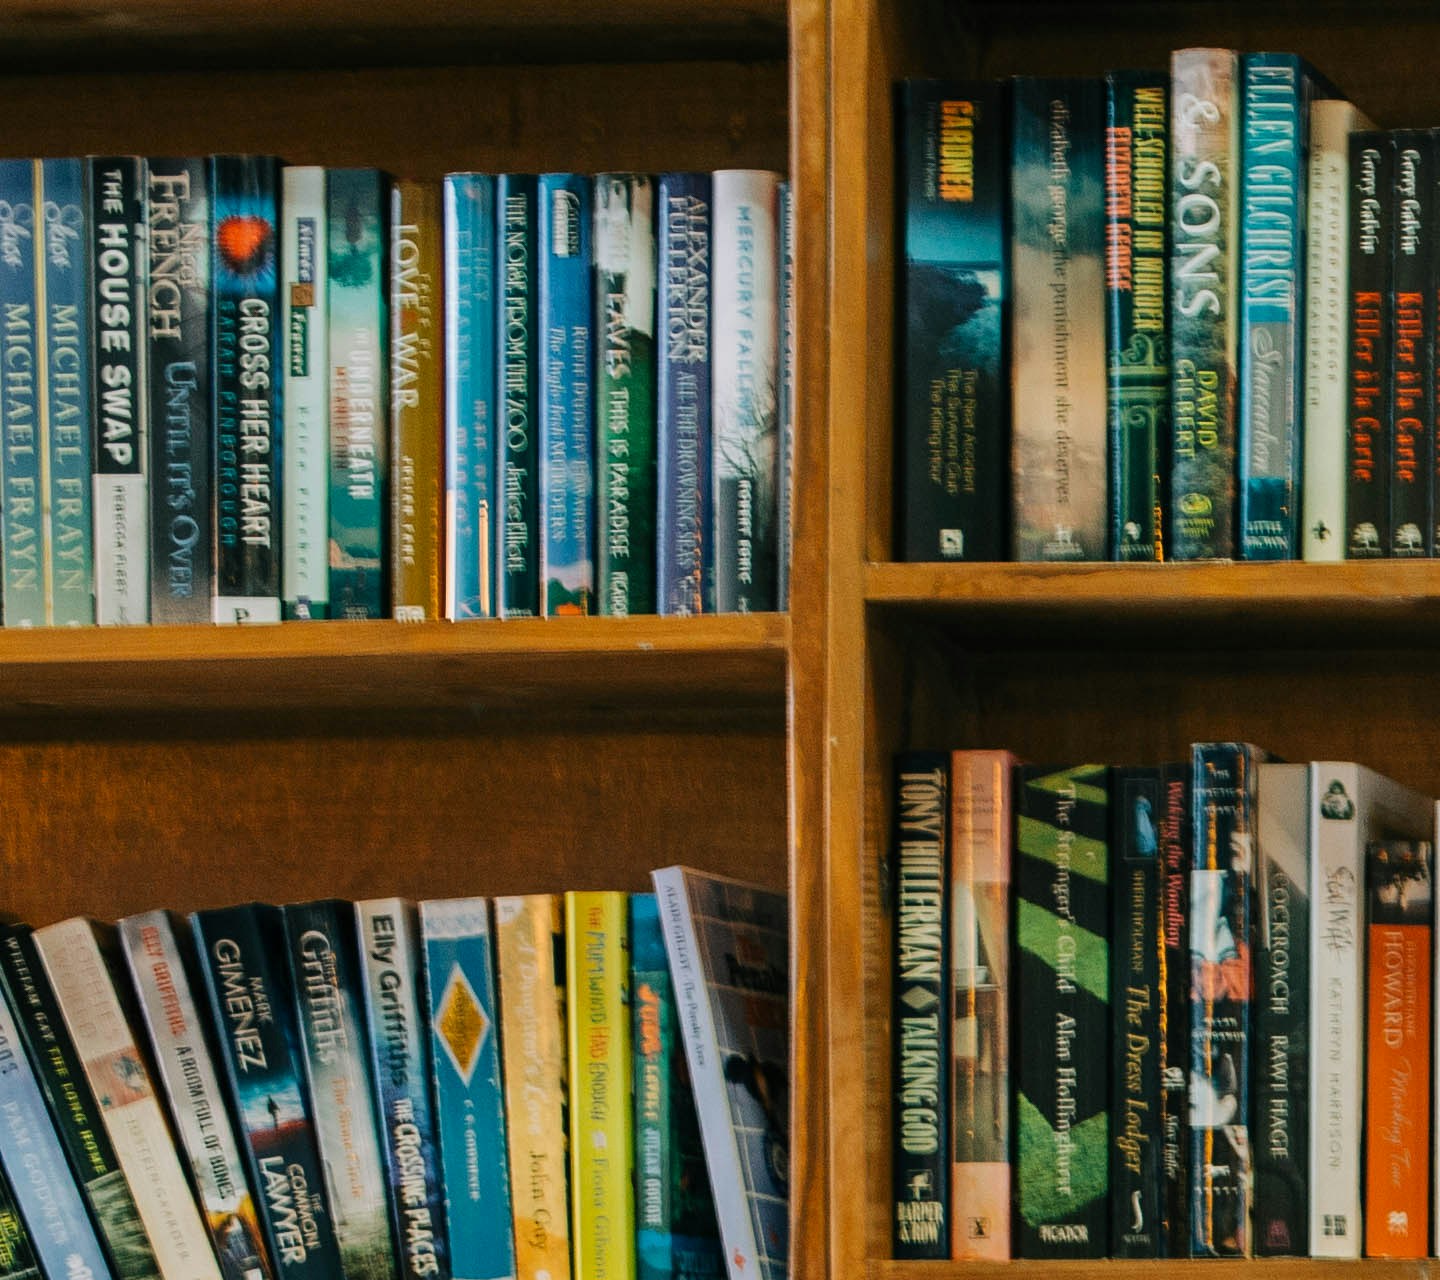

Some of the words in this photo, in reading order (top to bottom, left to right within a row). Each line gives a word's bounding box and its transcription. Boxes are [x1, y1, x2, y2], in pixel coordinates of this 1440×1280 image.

[103, 170, 125, 214] THE
[938, 101, 976, 201] GARDNER
[1178, 158, 1221, 318] SONS
[100, 223, 130, 349] HOUSE
[240, 298, 269, 390] CROSS
[101, 364, 132, 466] SWAP
[240, 399, 269, 450] HER
[240, 463, 271, 548] HEART
[900, 770, 944, 832] TONY
[367, 913, 399, 961] Elly
[903, 842, 944, 981] HILLERMAN
[215, 938, 265, 1074] GIMENEZ
[377, 970, 413, 1087] Griffiths
[900, 1018, 939, 1107] TALKING
[903, 1109, 939, 1153] GOD
